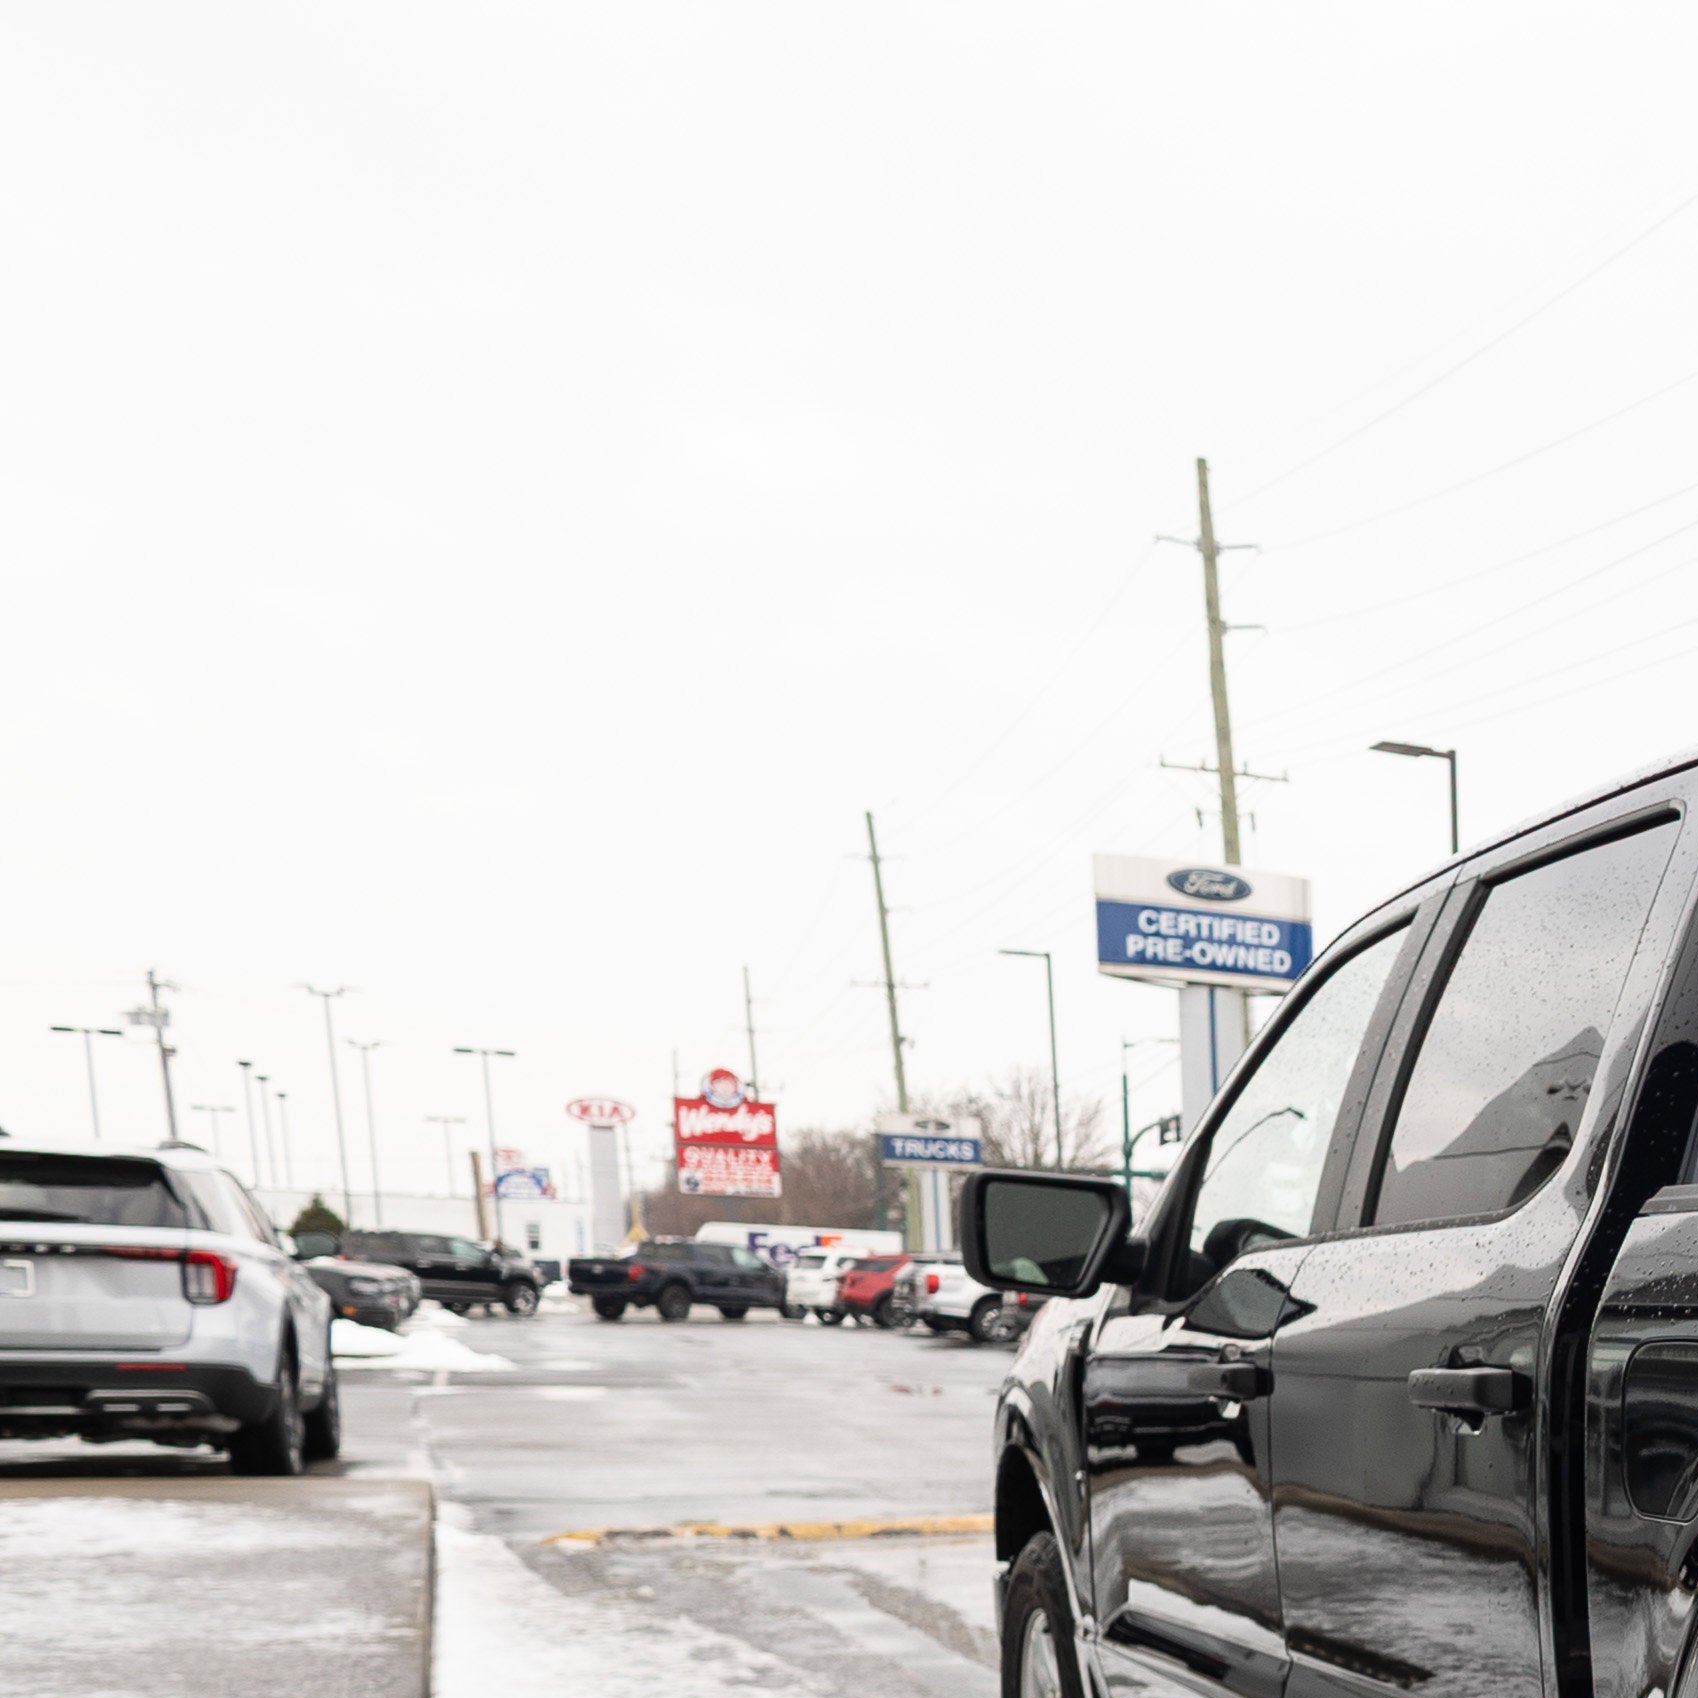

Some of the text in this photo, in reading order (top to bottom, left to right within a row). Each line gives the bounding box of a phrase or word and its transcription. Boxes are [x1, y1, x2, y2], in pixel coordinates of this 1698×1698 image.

[1138, 909, 1280, 946] CERTIFIED
[1126, 934, 1292, 973] PRE-OWNED
[579, 1103, 623, 1118] KIA
[679, 1104, 773, 1141] Wendy's
[891, 1137, 975, 1161] TRUCKS
